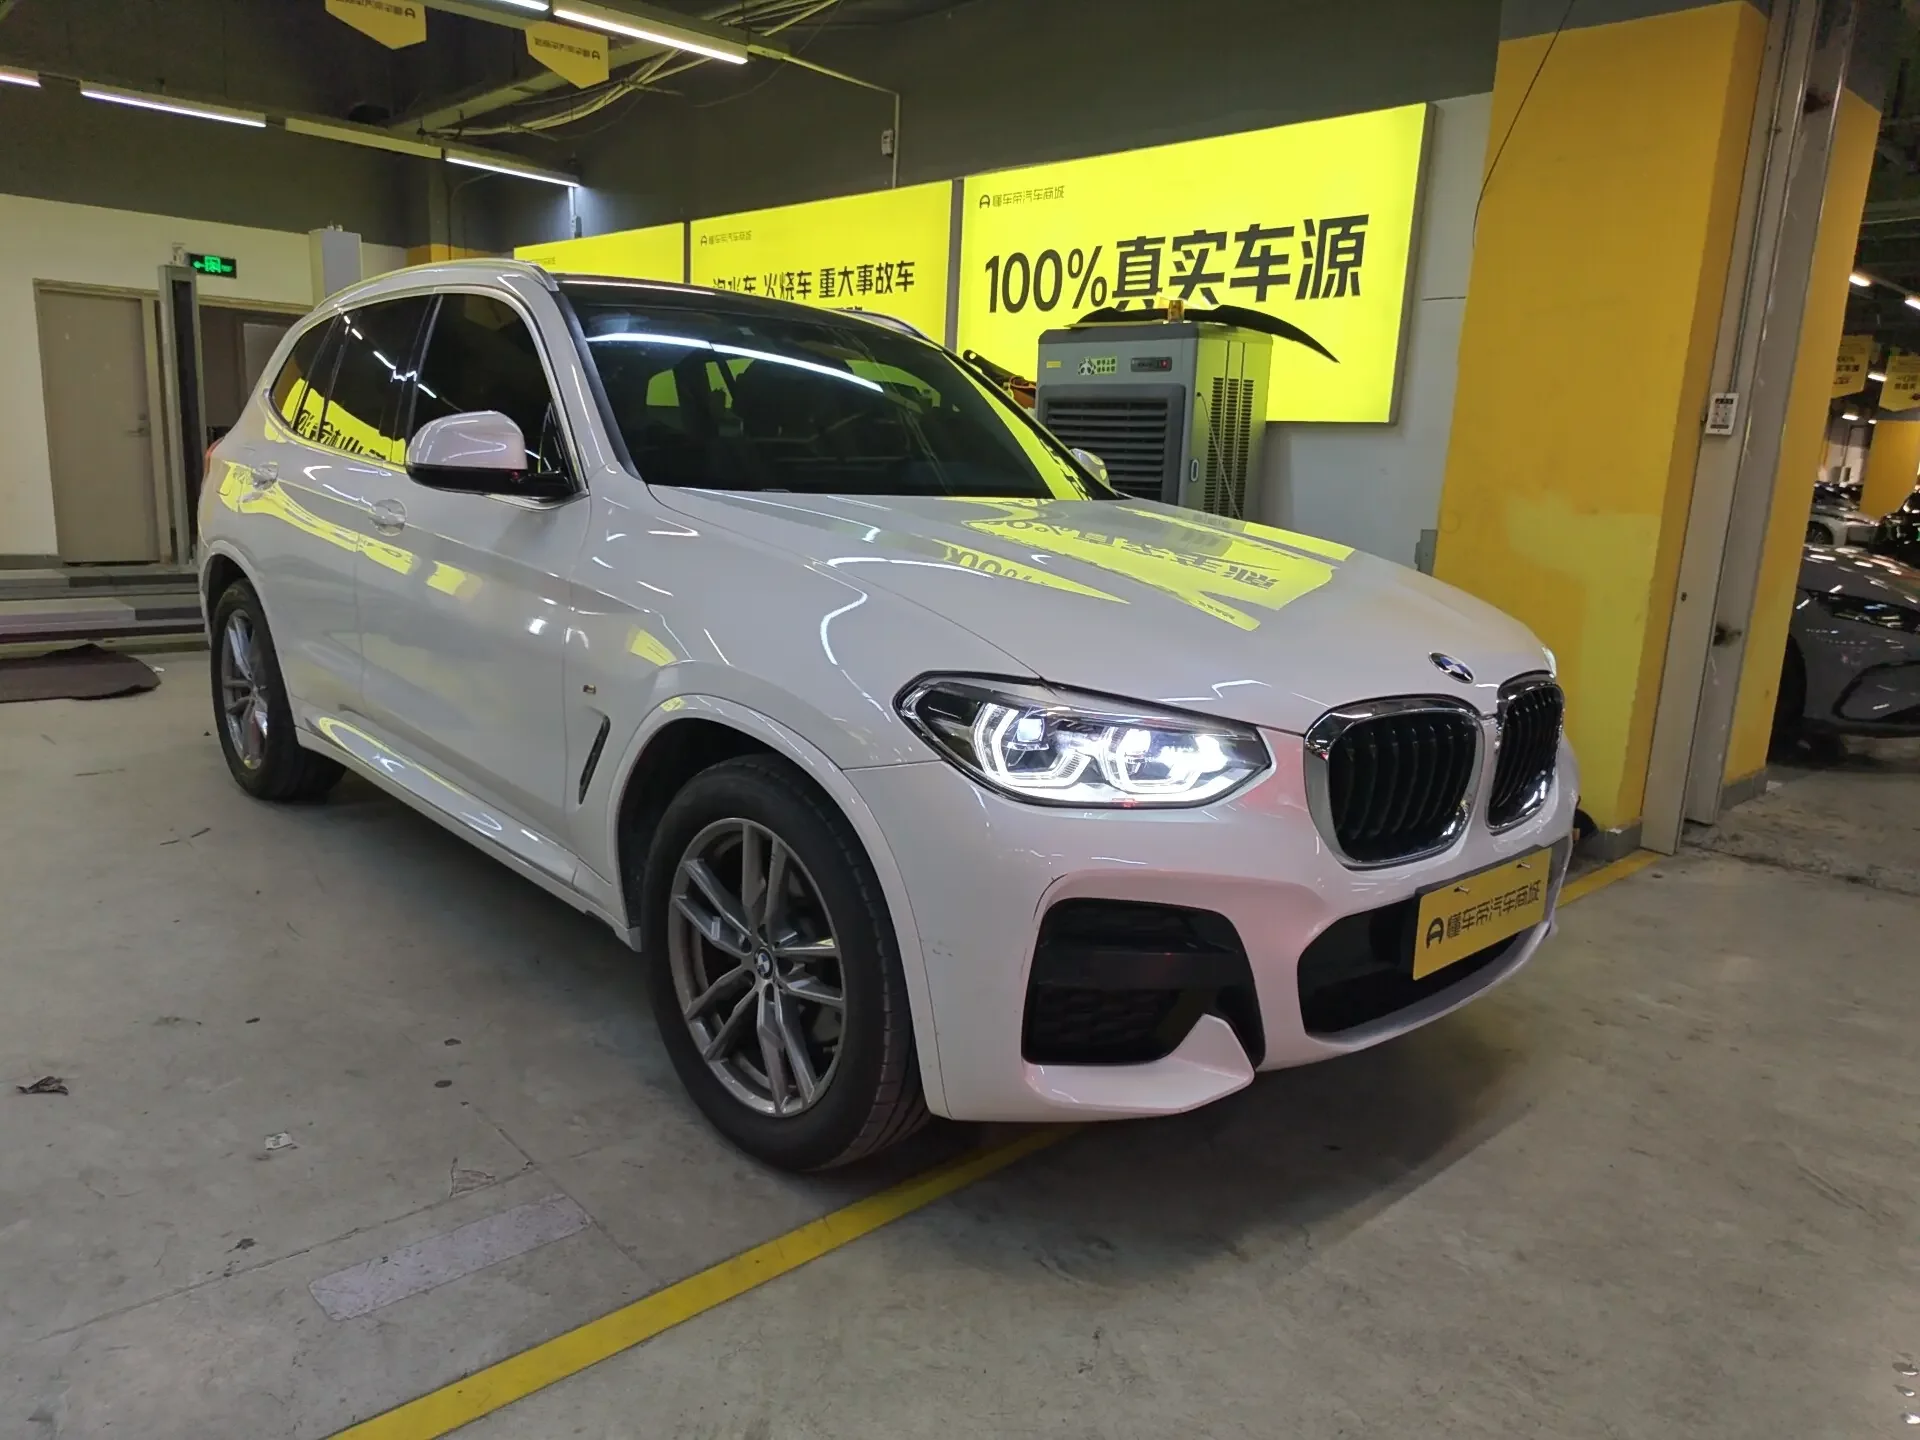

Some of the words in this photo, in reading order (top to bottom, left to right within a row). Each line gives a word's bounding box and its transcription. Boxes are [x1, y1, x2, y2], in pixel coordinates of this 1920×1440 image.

[763, 270, 813, 300] 火烧车
[818, 260, 916, 299] 重大事故车
[984, 213, 1370, 315] 100%真实车源
[1446, 879, 1542, 938] 懂车帝汽车商城
